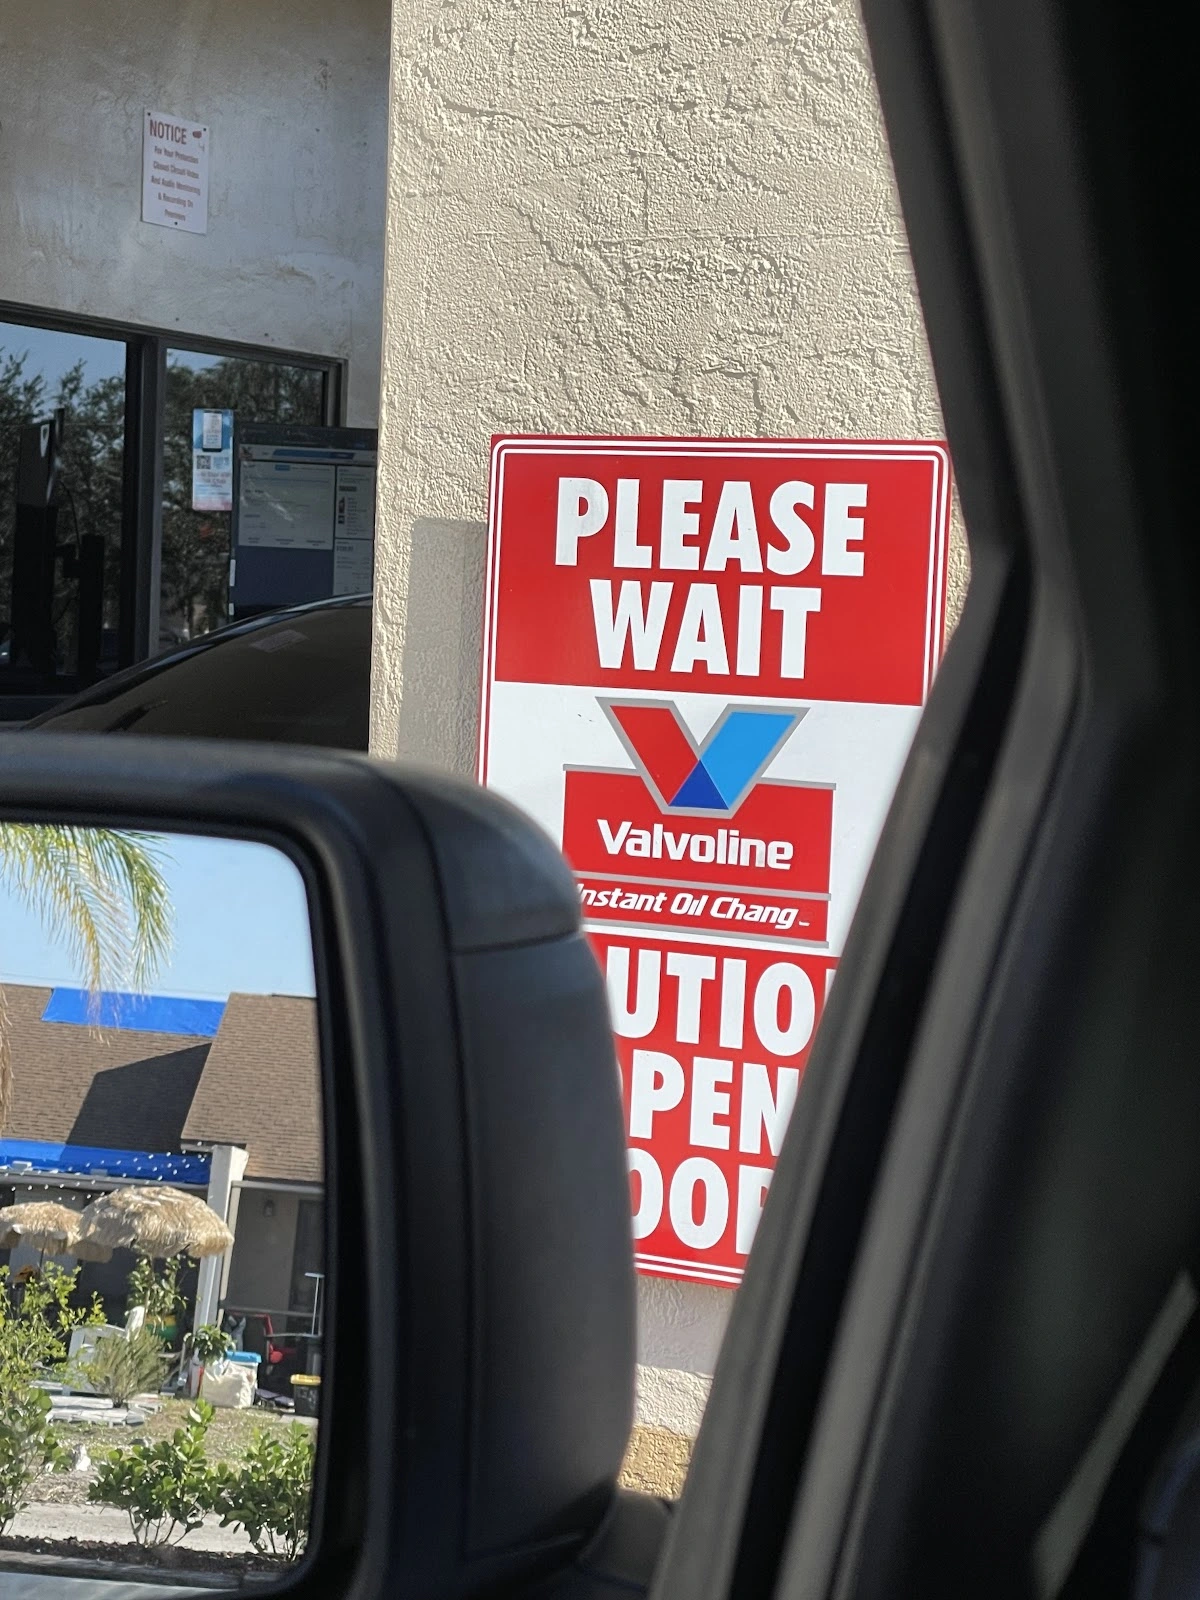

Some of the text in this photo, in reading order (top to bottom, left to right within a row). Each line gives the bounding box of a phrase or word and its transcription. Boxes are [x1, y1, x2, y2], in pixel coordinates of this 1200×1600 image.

[150, 119, 187, 145] NOTICE
[555, 477, 868, 577] PLEASE
[590, 579, 822, 680] WAIT
[596, 818, 795, 871] Valvoline
[669, 892, 709, 916] Oil
[710, 896, 811, 930] Chang
[616, 1048, 801, 1157] PEN
